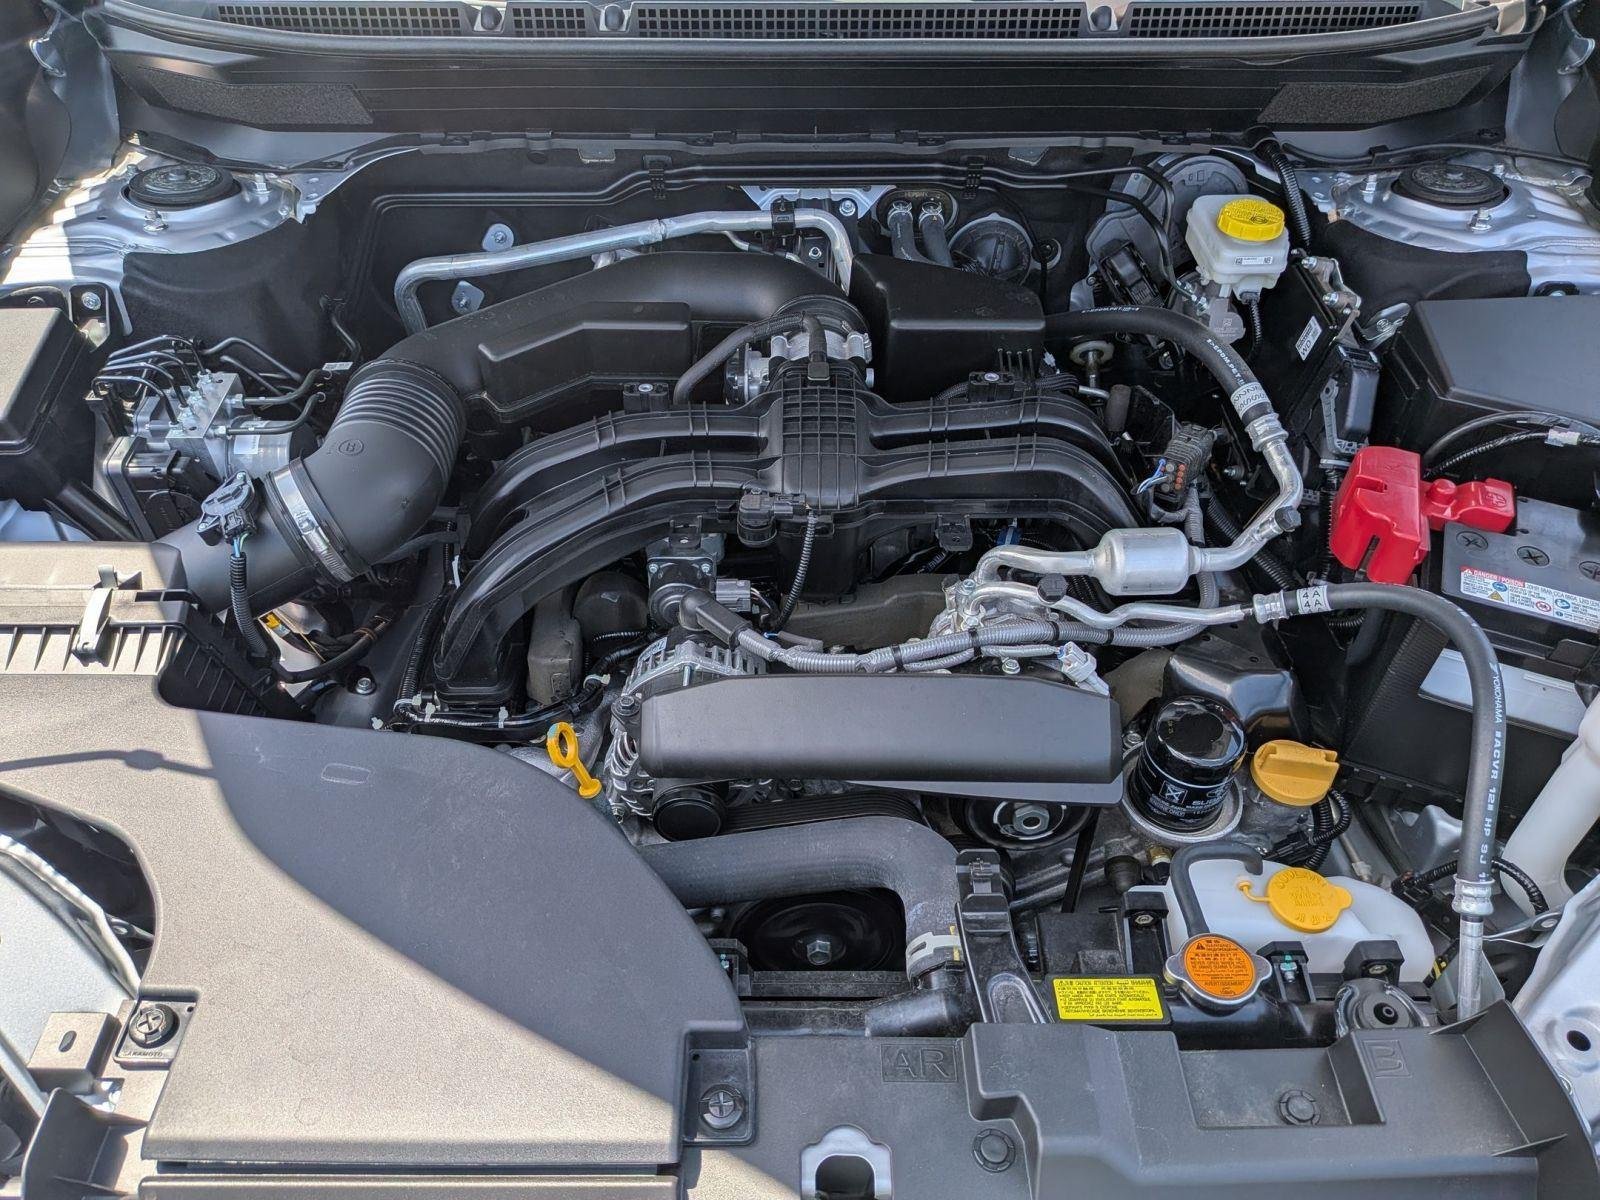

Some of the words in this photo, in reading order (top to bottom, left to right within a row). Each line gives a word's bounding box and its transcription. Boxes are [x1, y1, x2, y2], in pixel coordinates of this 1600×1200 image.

[1473, 569, 1498, 581] DANGER
[1502, 576, 1525, 587] POISON
[1492, 674, 1504, 724] YOKOHAMA
[896, 1047, 951, 1078] AR
